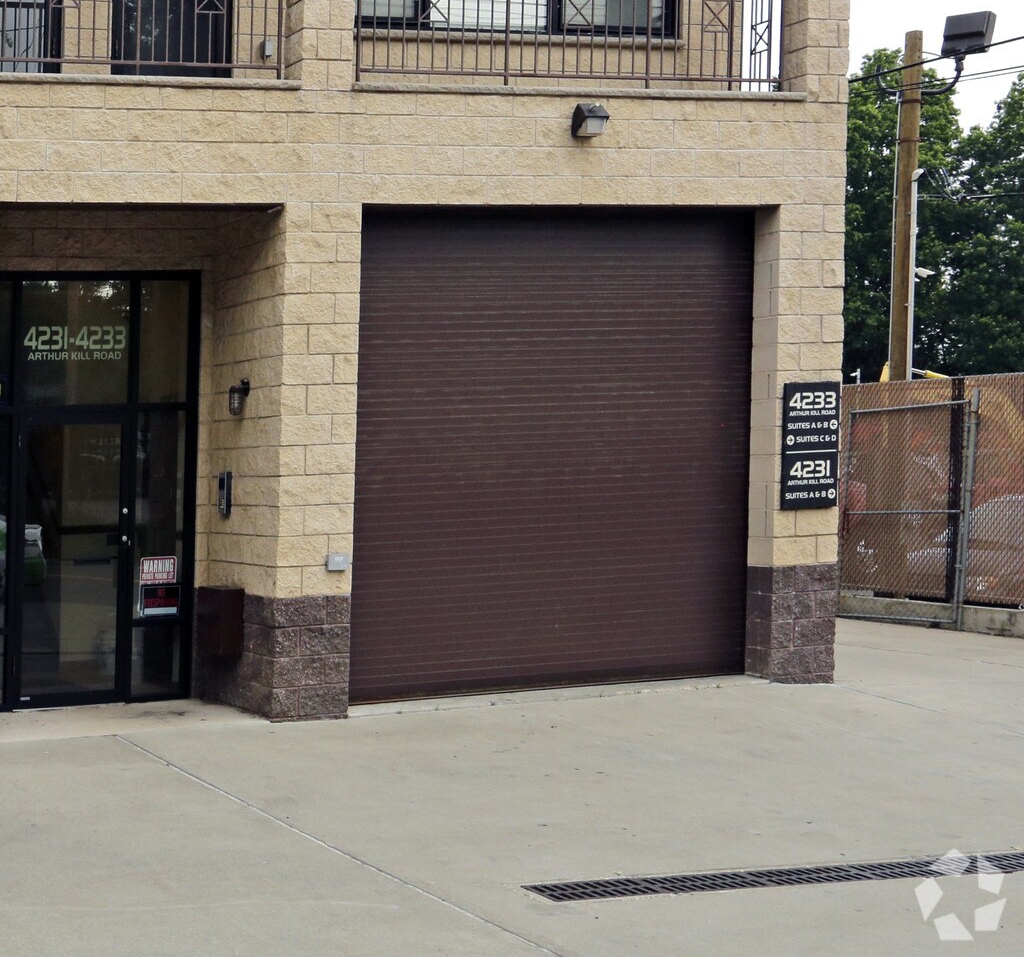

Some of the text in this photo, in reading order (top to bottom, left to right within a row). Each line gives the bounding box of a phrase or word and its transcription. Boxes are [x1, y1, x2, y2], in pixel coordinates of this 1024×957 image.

[23, 326, 126, 350] 4231-4233
[27, 351, 122, 361] ARTHUR KILL ROAD
[789, 391, 836, 409] 4233
[787, 422, 810, 430] SUITES
[796, 435, 819, 443] SUITES
[789, 460, 831, 478] 4231
[785, 491, 808, 499] SUITES
[143, 559, 174, 573] WARNING
